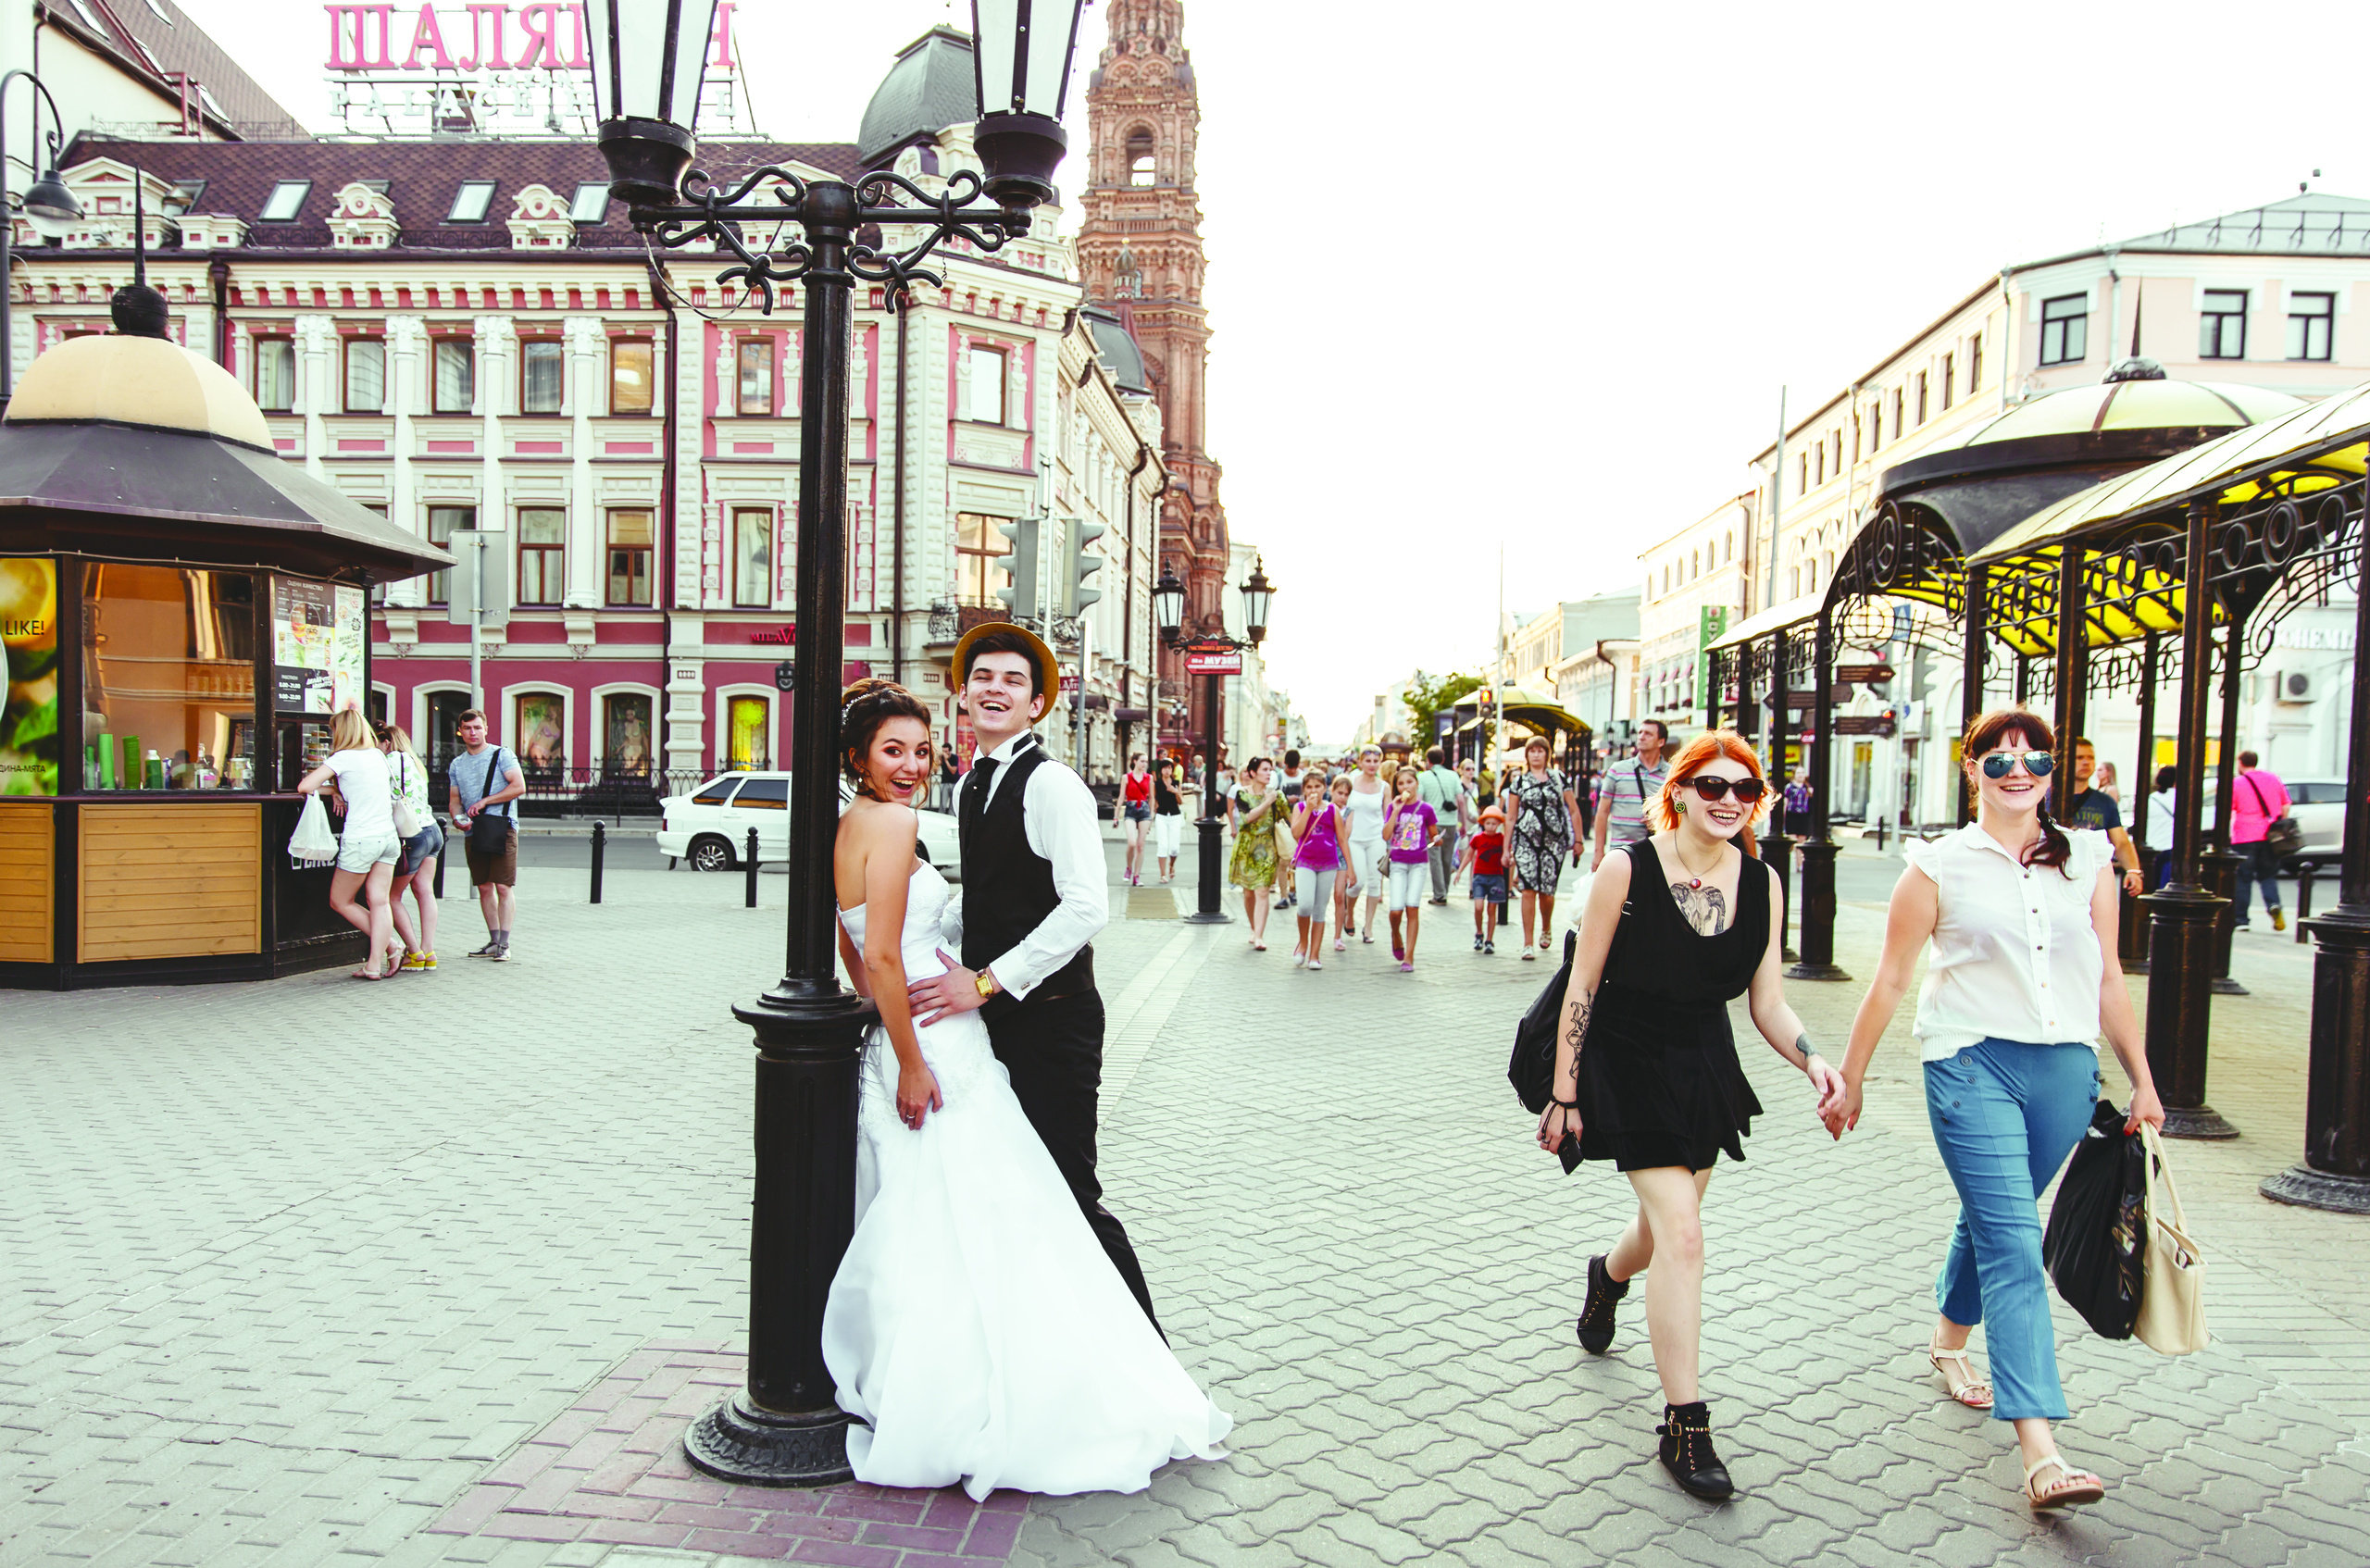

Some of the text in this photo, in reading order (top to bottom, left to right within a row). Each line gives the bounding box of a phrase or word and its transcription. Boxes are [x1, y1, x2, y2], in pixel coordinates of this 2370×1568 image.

[488, 74, 575, 89] KAZAN
[329, 89, 534, 118] PALACE
[6, 620, 44, 636] LIKE!
[1204, 655, 1241, 665] МУЗЕЙ
